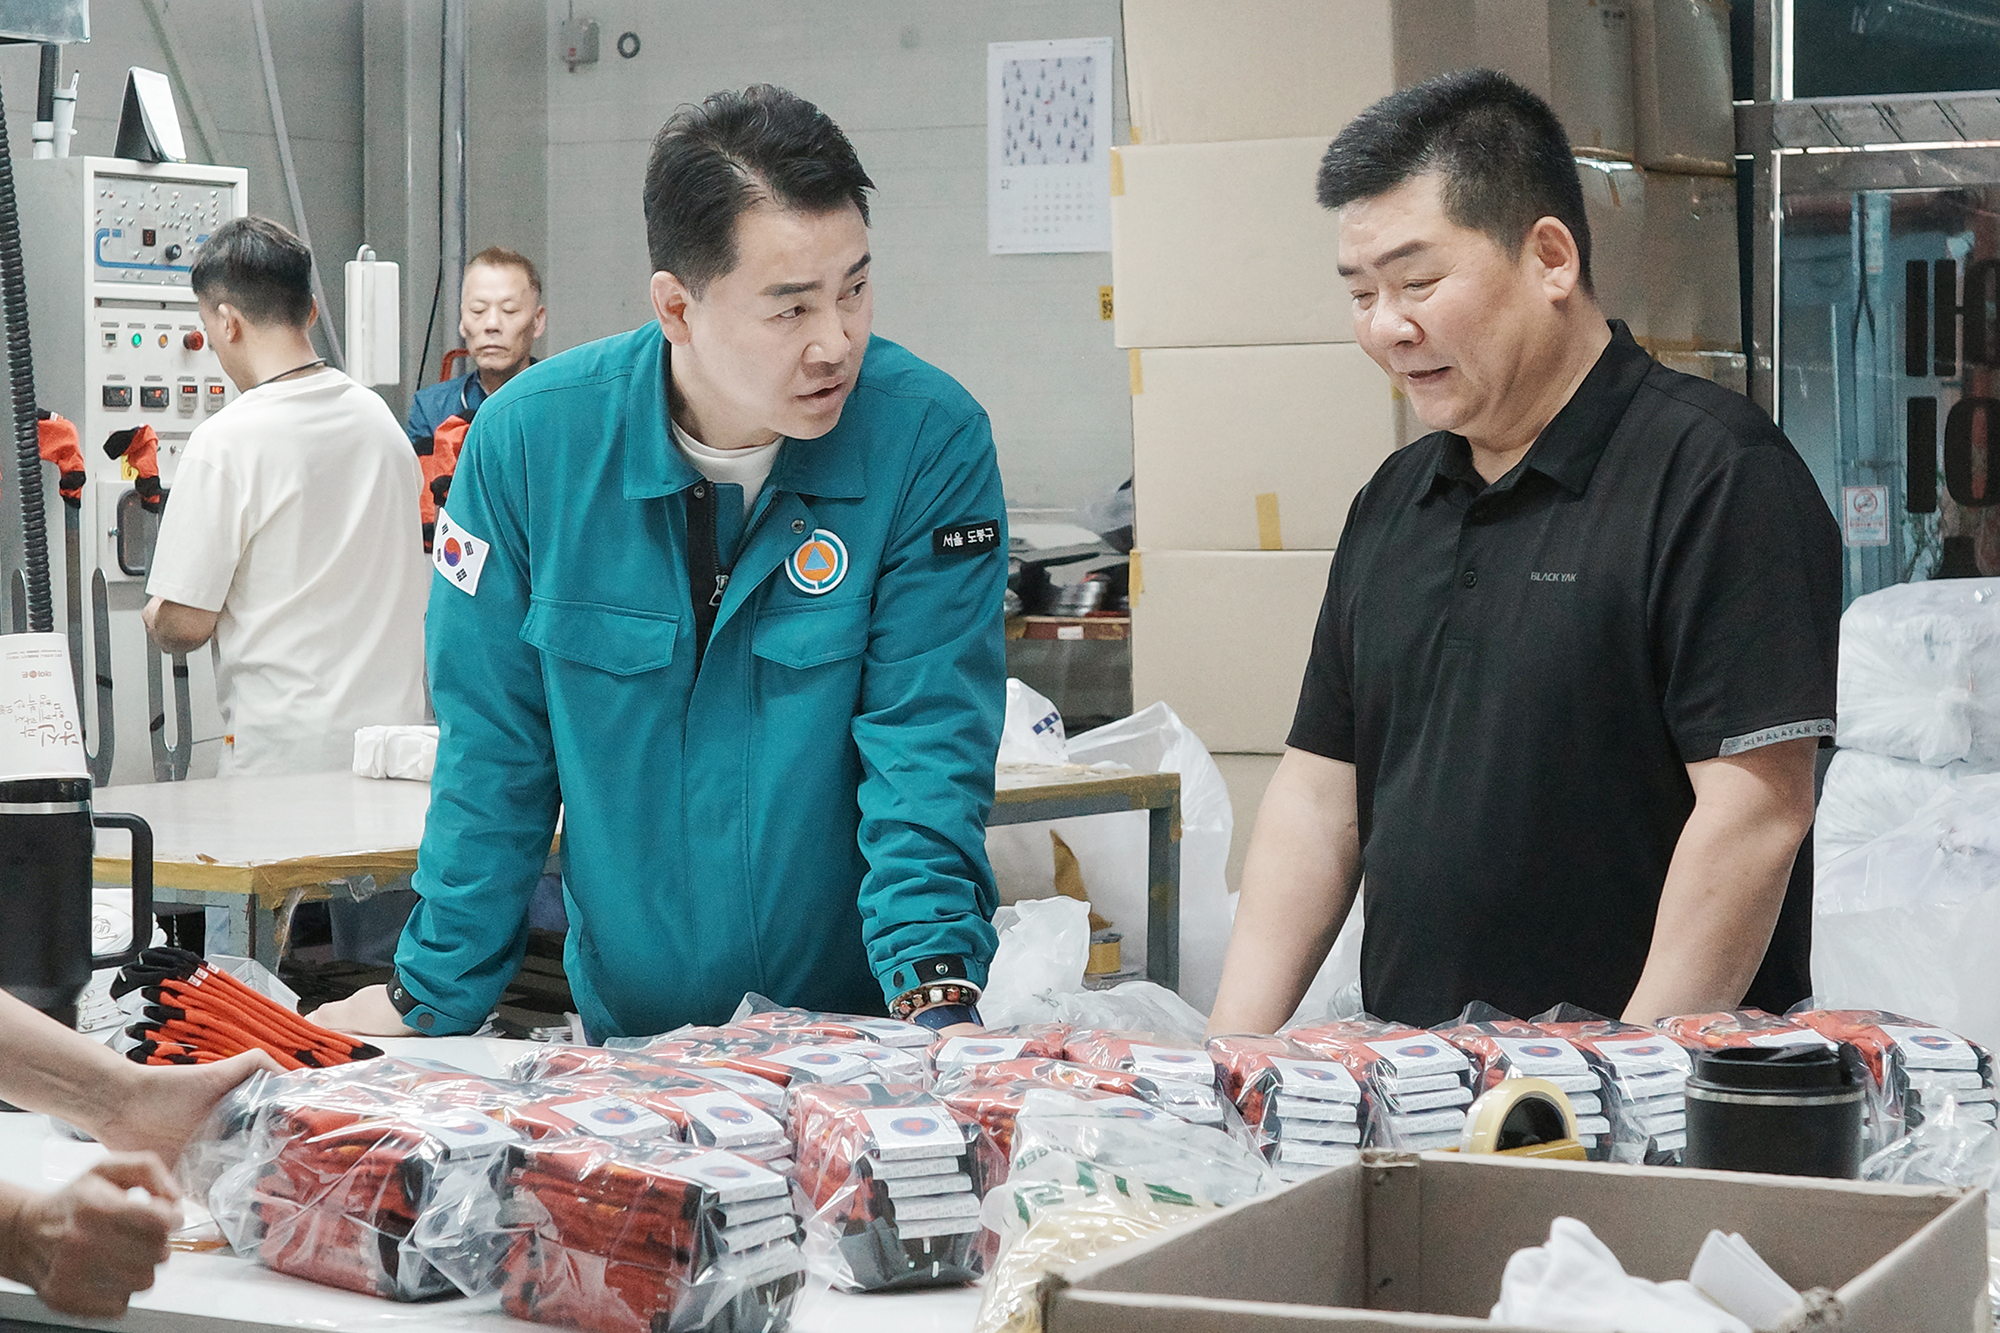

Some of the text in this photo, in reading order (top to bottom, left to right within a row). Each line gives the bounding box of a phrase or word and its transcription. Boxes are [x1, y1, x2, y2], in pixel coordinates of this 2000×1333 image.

[942, 527, 995, 548] 서울 도봉구
[19, 720, 80, 747] 당신과
[1743, 723, 1834, 747] HIMALAYAN OR
